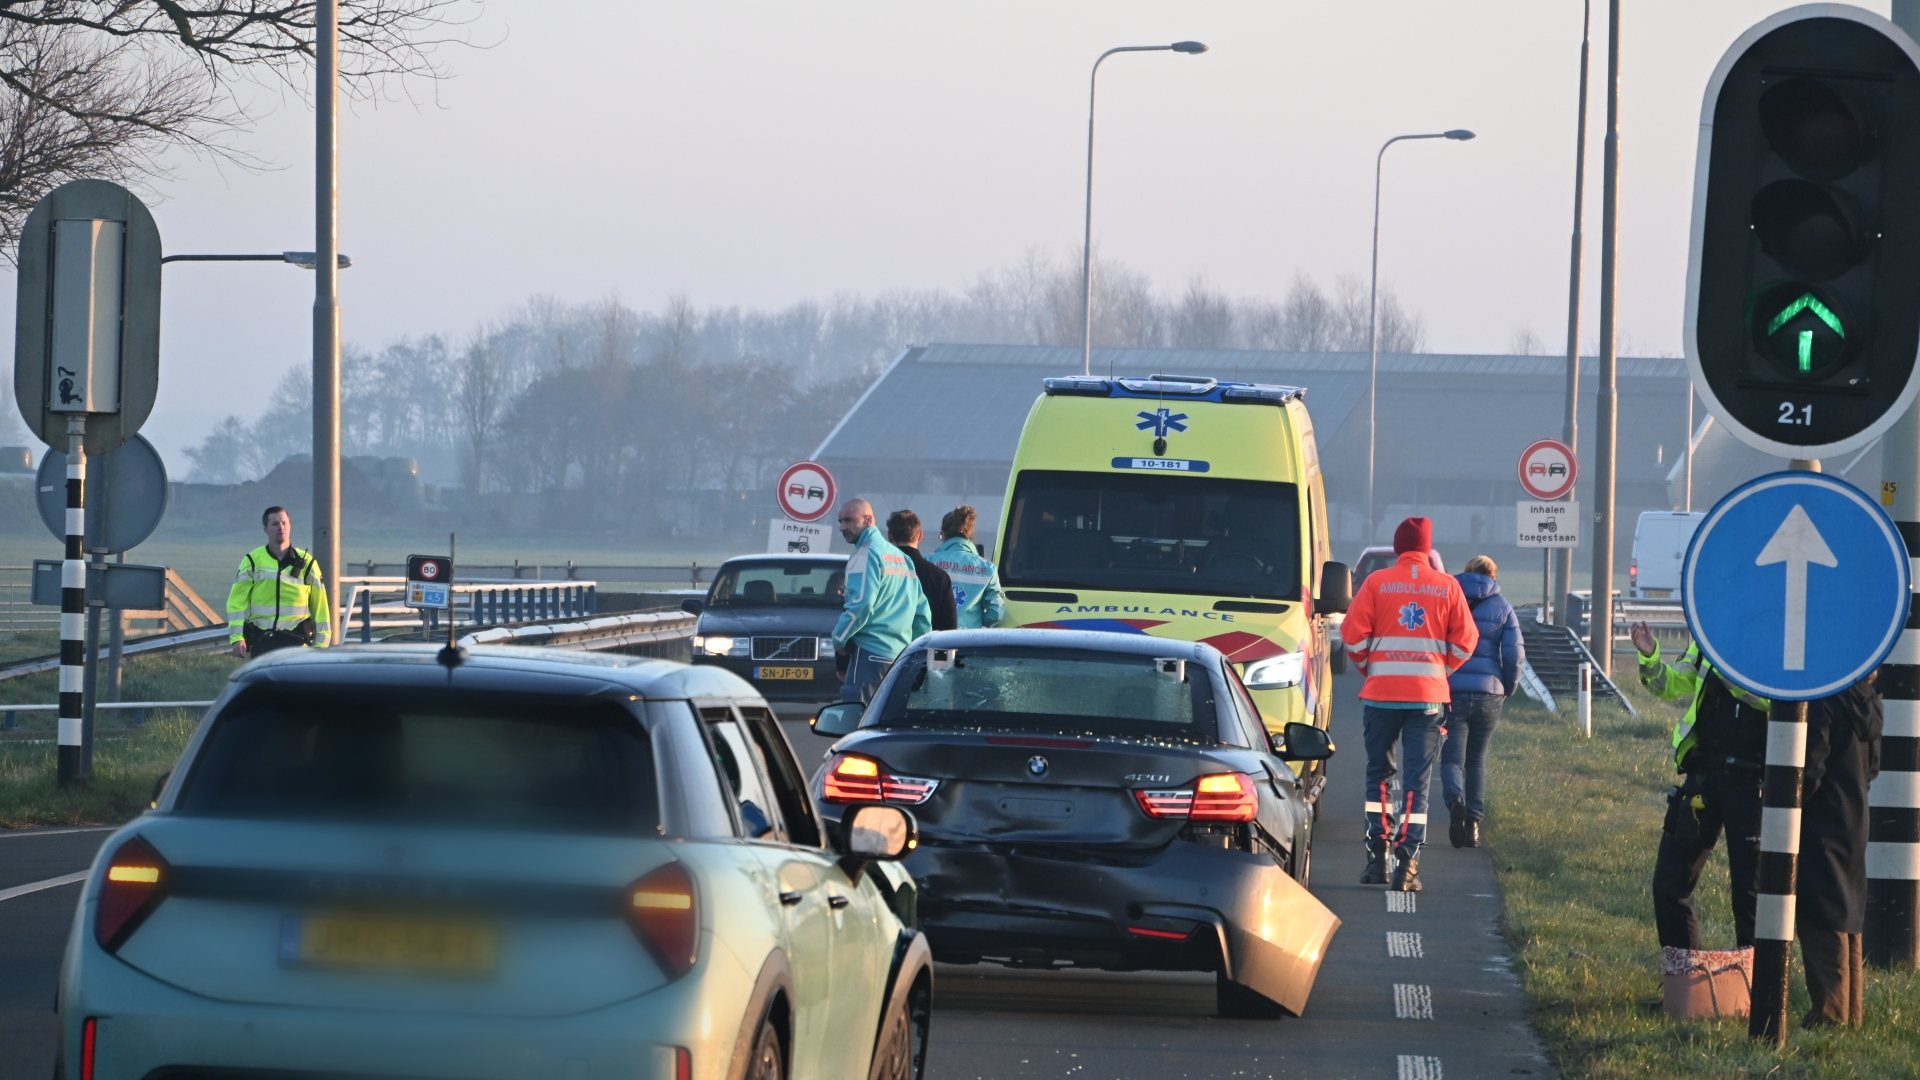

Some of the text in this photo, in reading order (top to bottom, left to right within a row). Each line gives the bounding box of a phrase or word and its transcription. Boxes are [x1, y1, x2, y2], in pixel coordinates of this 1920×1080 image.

[1778, 402, 1813, 426] 2.1
[1141, 460, 1181, 469] 10-181
[1530, 505, 1565, 514] inhalen
[783, 523, 820, 535] inhalen
[1519, 533, 1576, 543] toegestaan
[423, 566, 436, 574] 80
[935, 561, 987, 575] MBULANCE
[1379, 582, 1449, 599] AMBULANCE
[427, 593, 441, 603] 4,5
[1055, 605, 1235, 623] AMBULANCE
[761, 668, 809, 678] SN-JF-09
